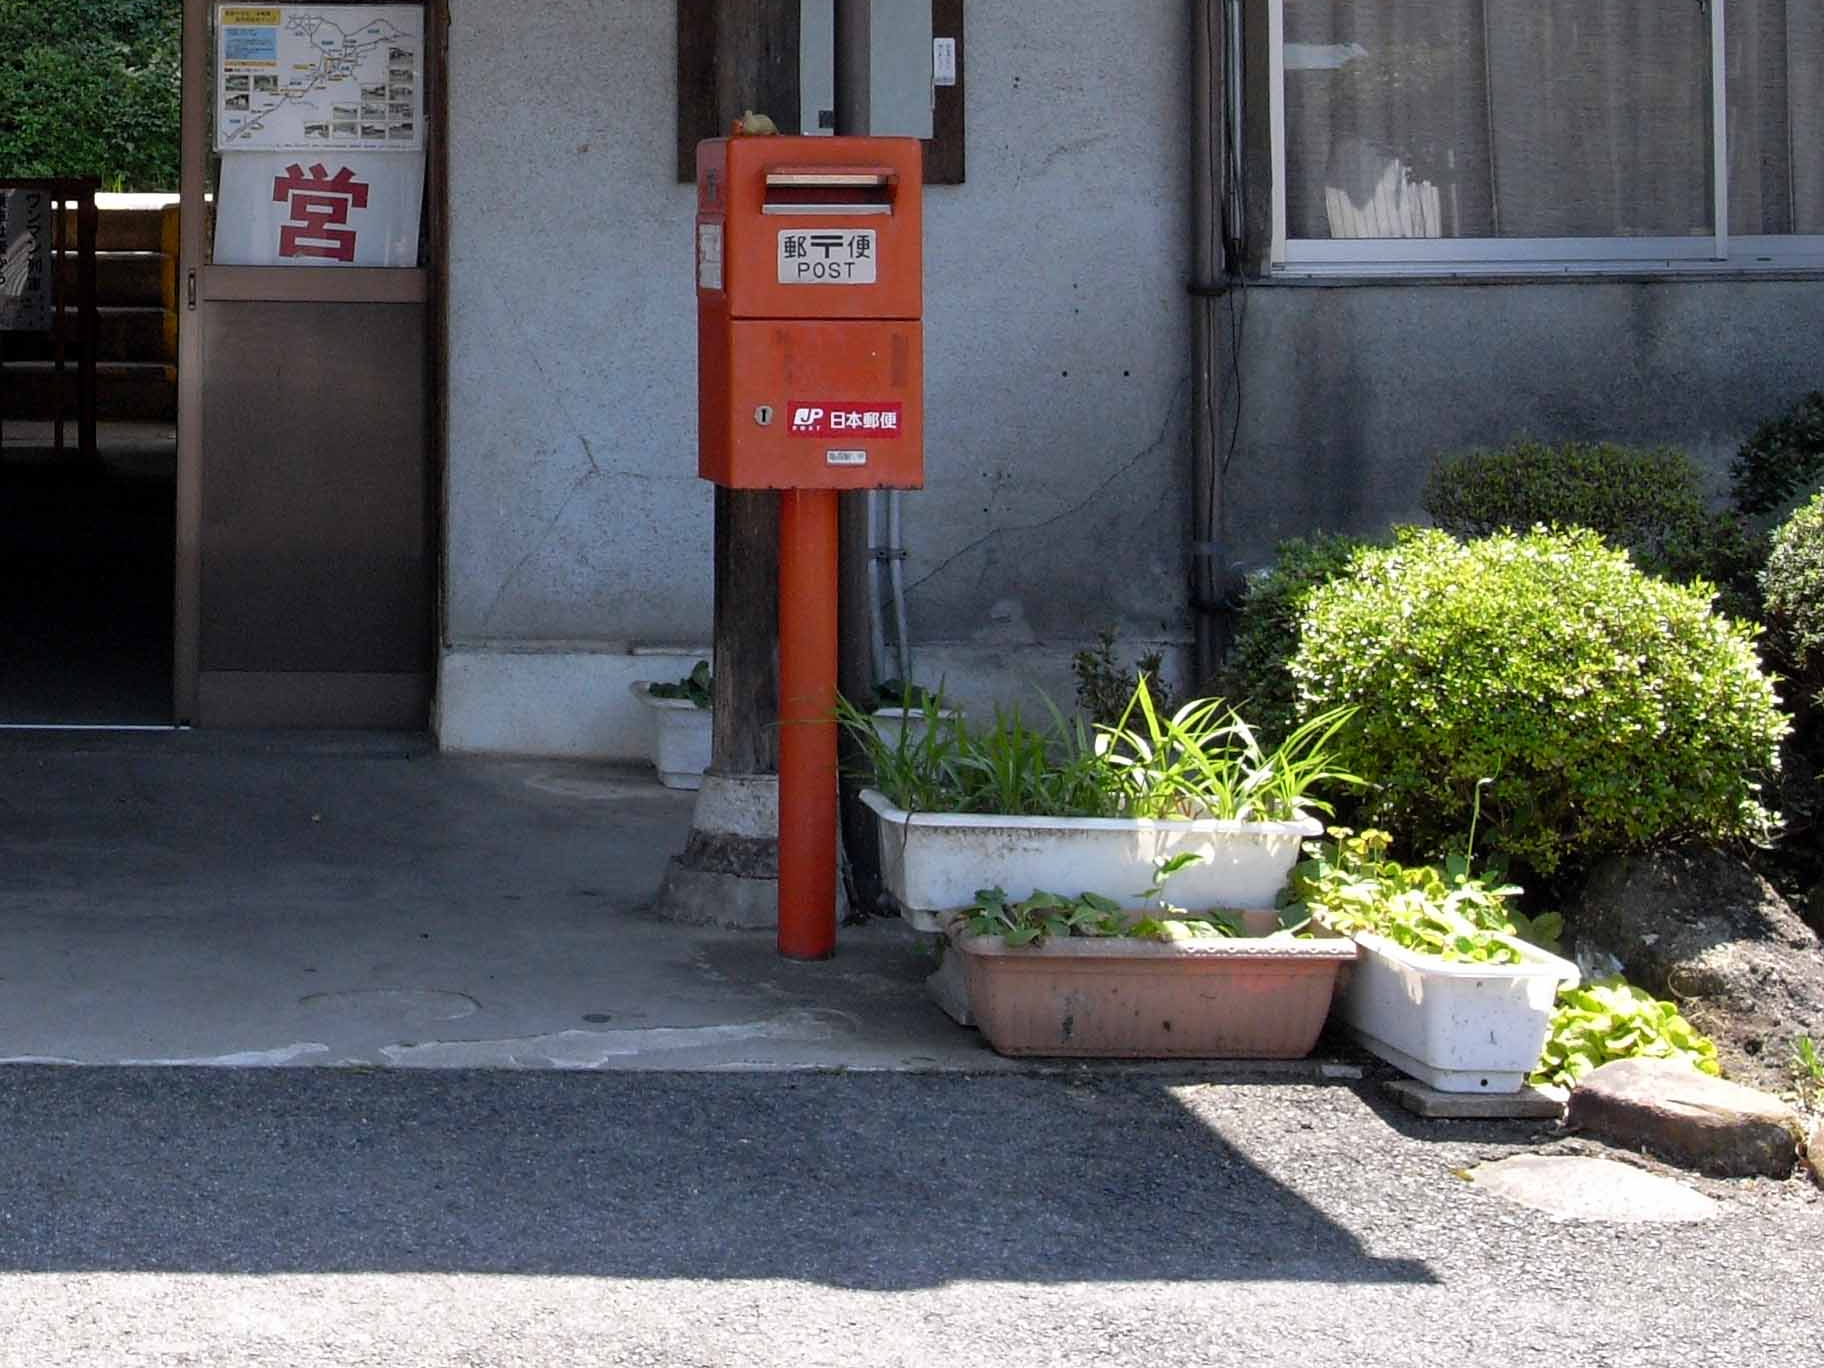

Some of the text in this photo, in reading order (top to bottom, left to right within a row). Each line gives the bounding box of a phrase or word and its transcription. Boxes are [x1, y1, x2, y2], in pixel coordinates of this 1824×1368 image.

[272, 163, 369, 262] 営
[798, 262, 855, 279] POST
[830, 412, 897, 430] 日本郵便
